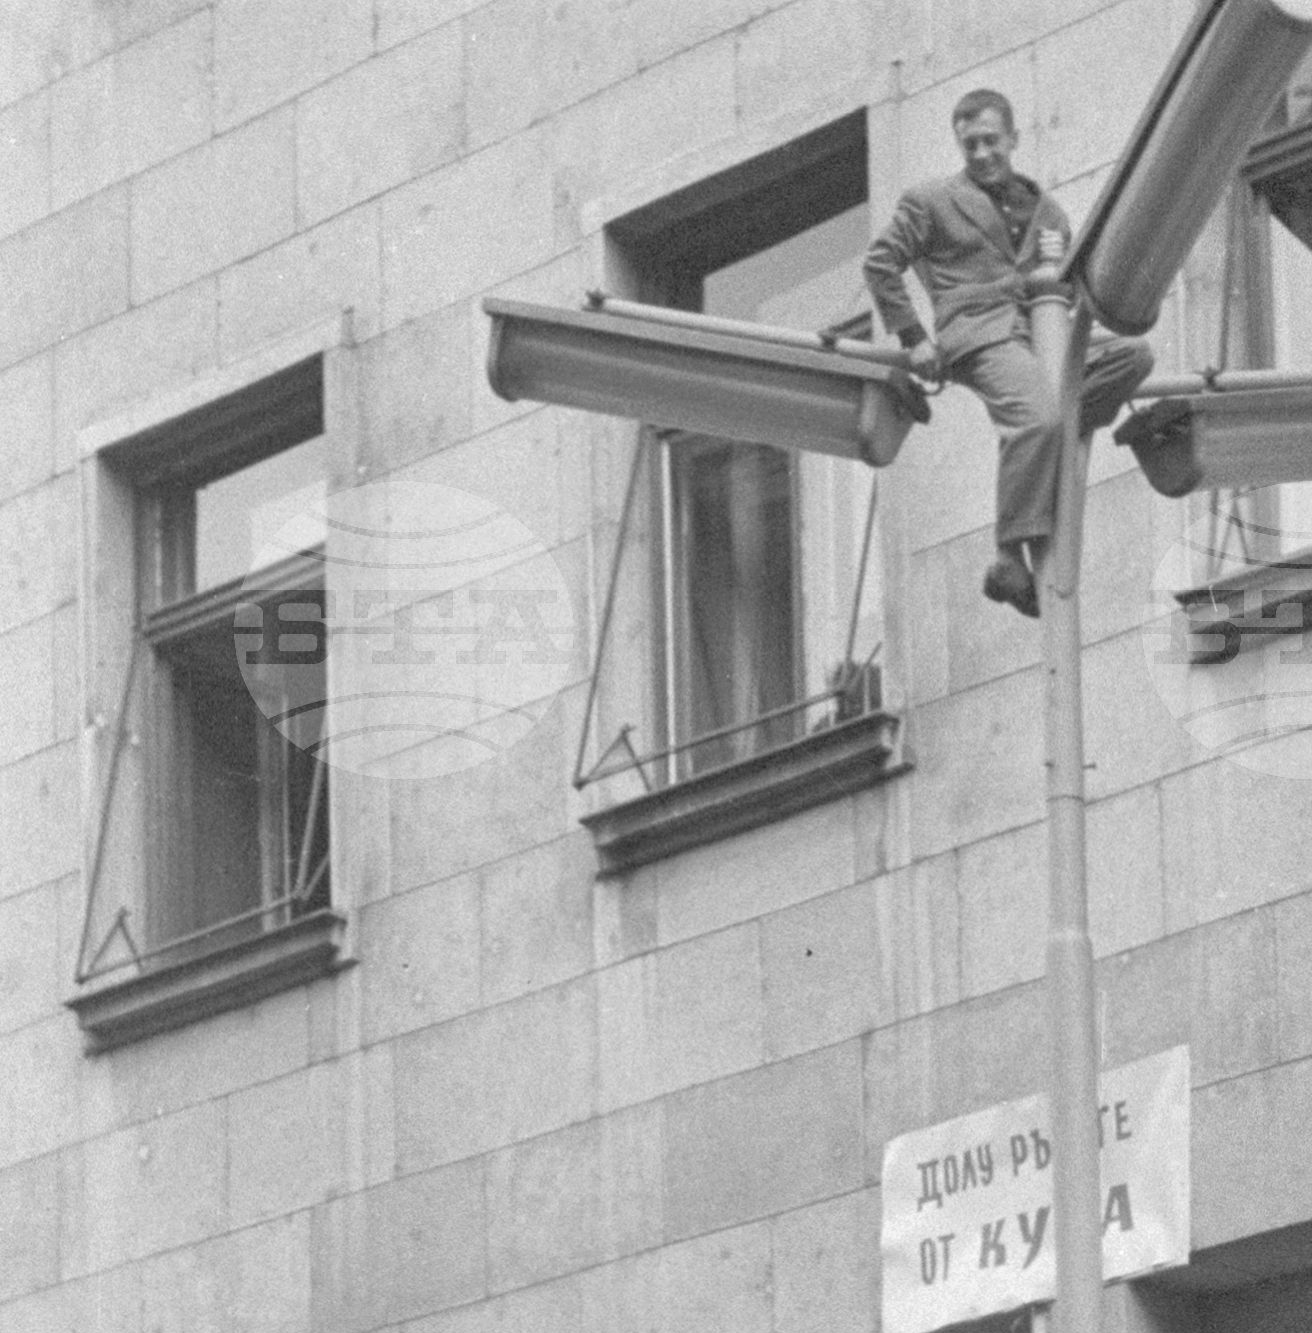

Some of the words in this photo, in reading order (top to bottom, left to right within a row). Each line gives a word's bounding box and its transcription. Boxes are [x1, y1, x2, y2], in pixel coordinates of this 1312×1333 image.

[917, 1143, 995, 1213] ДОЛУ
[919, 1232, 955, 1286] ОТ
[978, 1182, 1135, 1271] КУА
